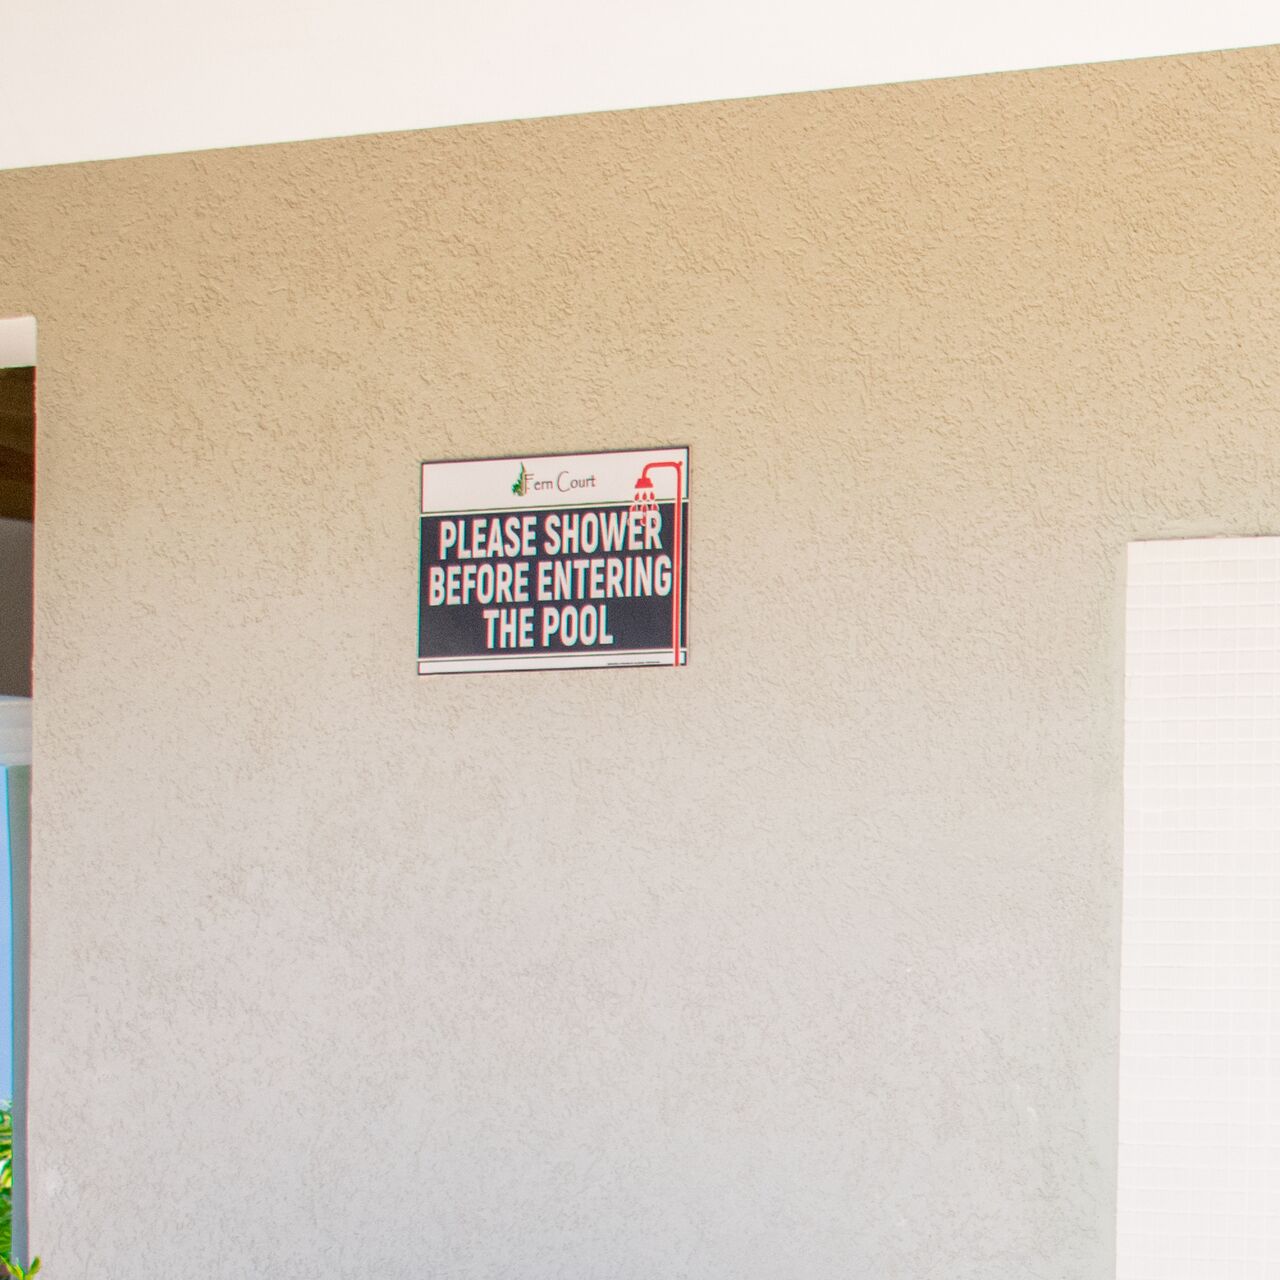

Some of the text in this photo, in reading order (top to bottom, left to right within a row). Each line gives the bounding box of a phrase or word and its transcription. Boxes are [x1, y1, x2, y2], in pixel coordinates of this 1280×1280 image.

[520, 470, 596, 496] Fern Court
[439, 509, 664, 561] PLEASE SHOWER
[428, 554, 673, 607] BEFORE ENTERING
[483, 604, 614, 650] THE POOL
